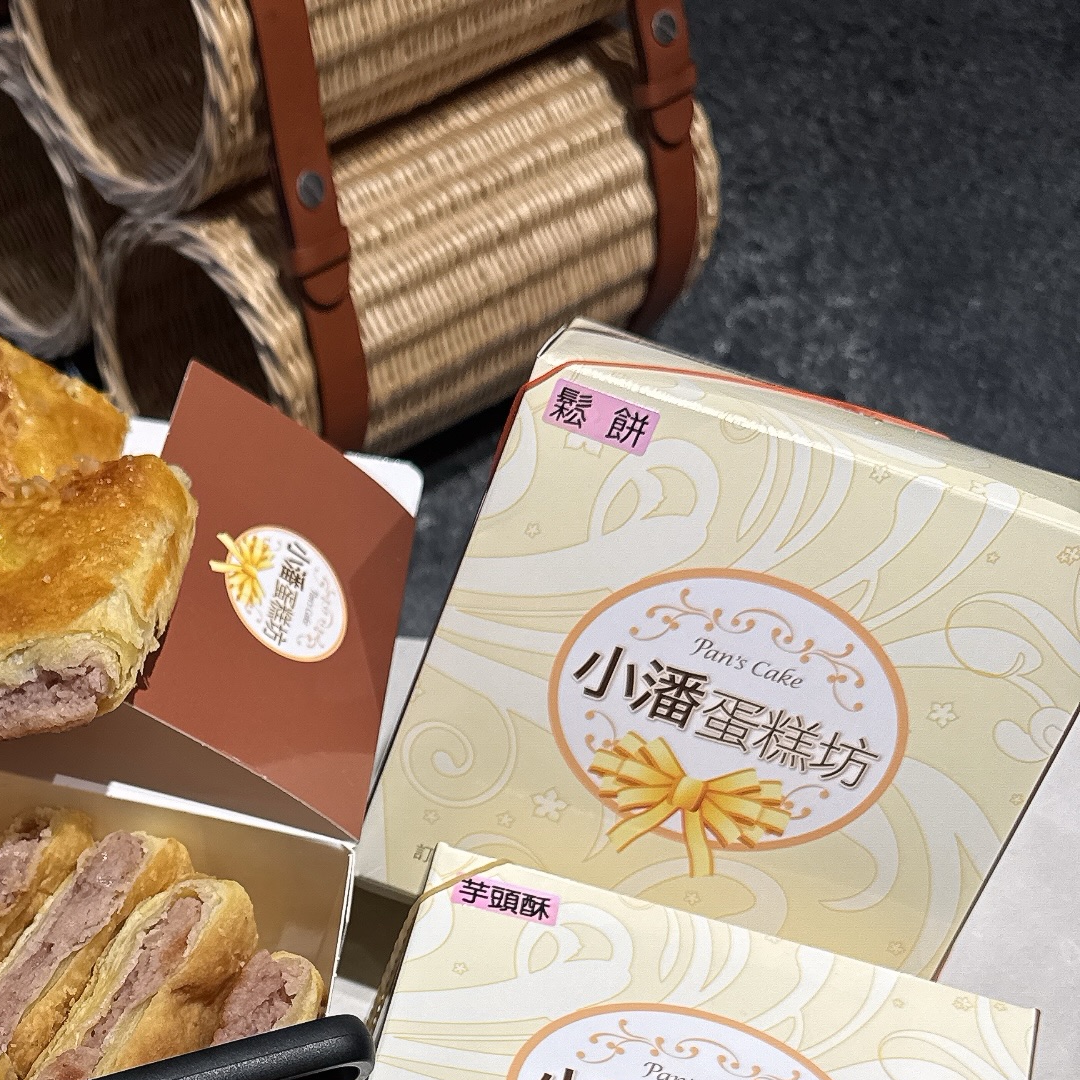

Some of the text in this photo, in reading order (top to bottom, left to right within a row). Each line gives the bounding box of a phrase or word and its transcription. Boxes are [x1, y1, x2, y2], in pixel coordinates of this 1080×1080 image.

[263, 541, 311, 646] 小潘蛋糕坊
[689, 637, 804, 689] Pan's Cake
[572, 646, 879, 788] 小潘蛋糕坊
[459, 878, 552, 921] 芋頭酥
